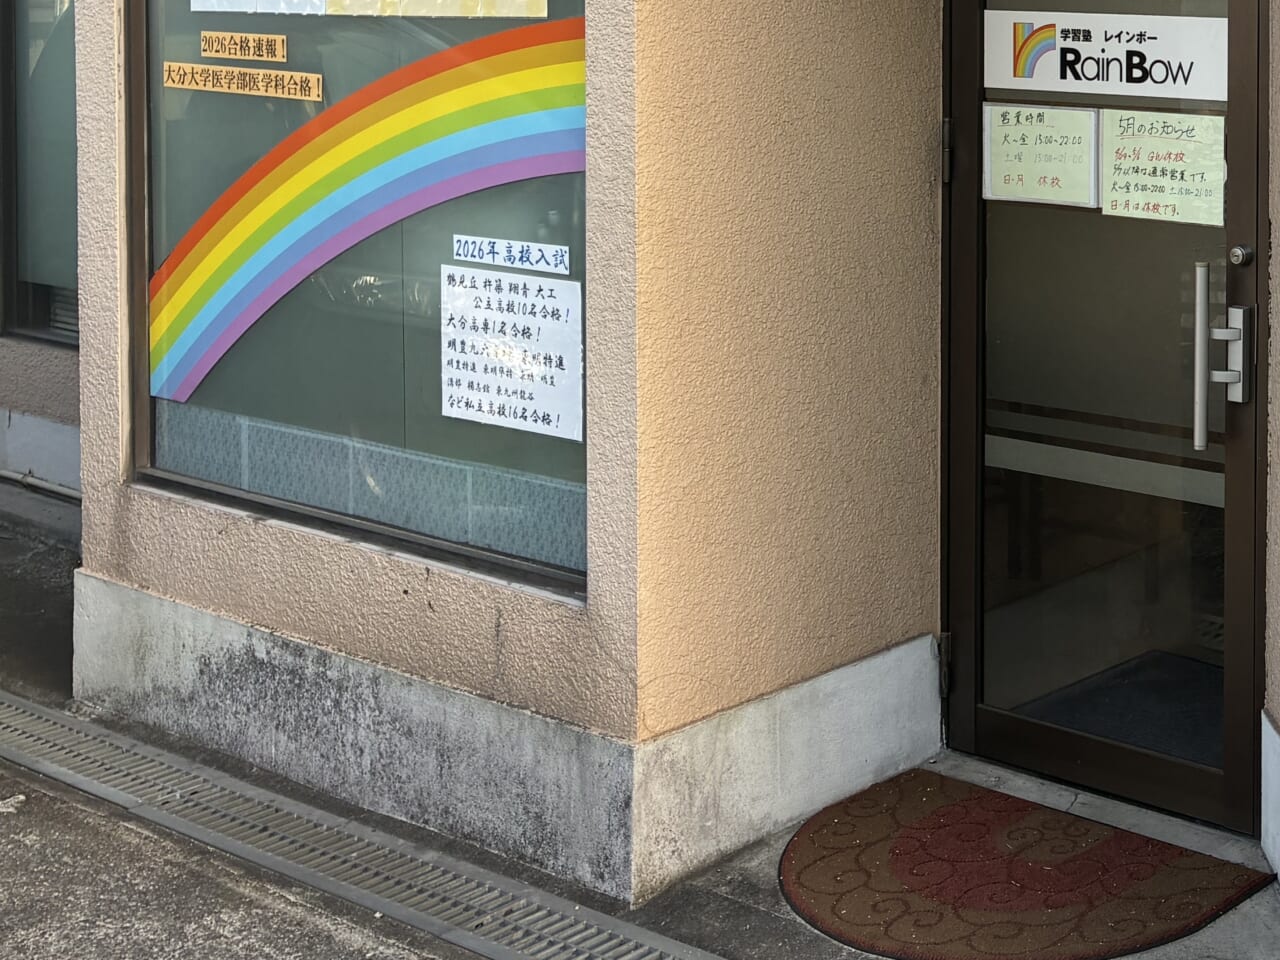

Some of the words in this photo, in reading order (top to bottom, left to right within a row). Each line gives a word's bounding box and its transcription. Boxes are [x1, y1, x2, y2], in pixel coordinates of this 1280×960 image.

[202, 35, 286, 58] 2026合格速報!
[1060, 28, 1092, 42] 学習塾
[1104, 30, 1158, 44] レインボー
[1059, 46, 1194, 85] RainBow
[165, 65, 321, 98] 大分大学医学部医学科合格!
[1000, 110, 1045, 126] 営業時間
[1119, 116, 1196, 140] 5月のお知らせ
[1038, 176, 1062, 188] 休校
[535, 285, 557, 300] 大工
[473, 296, 570, 323] 公立高校10名合格!
[447, 313, 541, 342] 大分高専1名合格!
